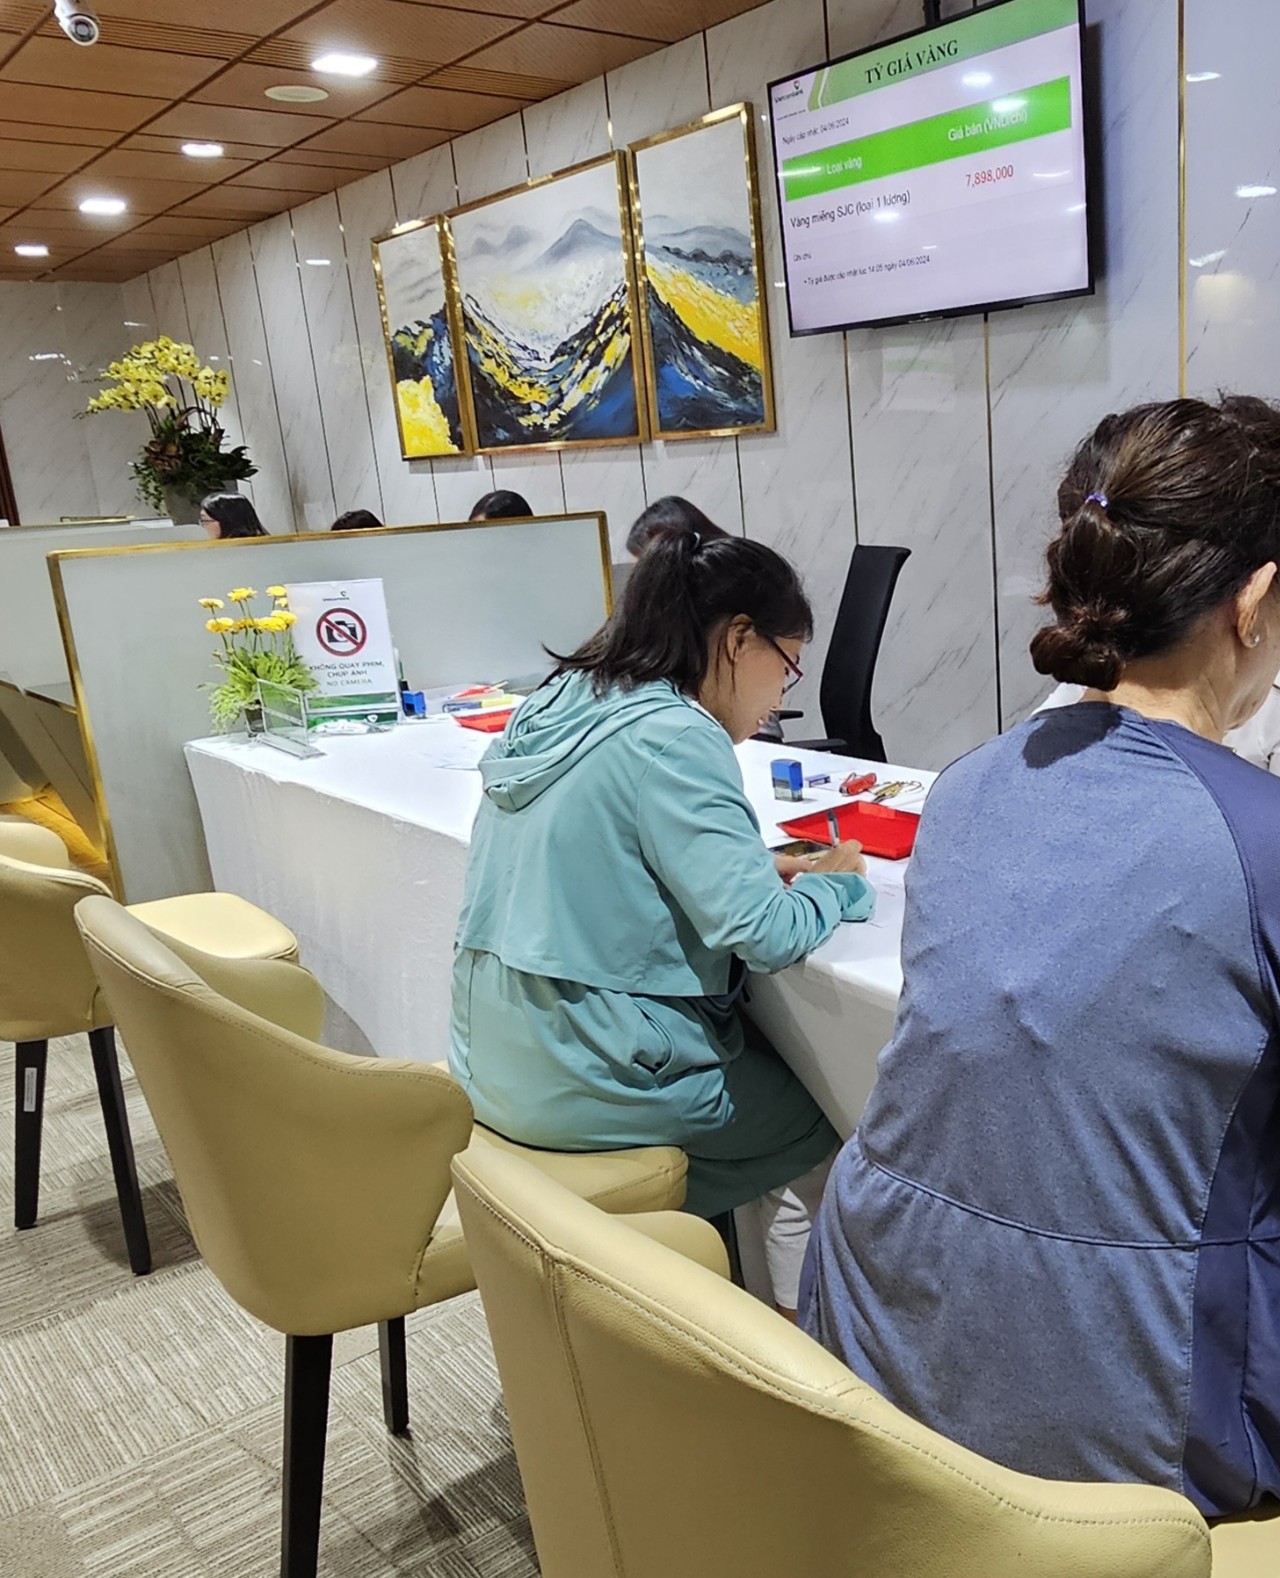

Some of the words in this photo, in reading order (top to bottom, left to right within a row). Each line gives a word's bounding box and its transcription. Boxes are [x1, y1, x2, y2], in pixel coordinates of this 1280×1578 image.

[887, 52, 912, 76] GIÁ
[916, 40, 958, 66] VÀNG
[948, 125, 963, 141] Giá
[965, 121, 981, 137] bán
[966, 165, 1014, 187] 7,898,000
[790, 217, 810, 229] Vàng
[812, 209, 835, 223] miếng
[837, 203, 854, 218] SJC
[309, 663, 337, 671] KHÔNG
[339, 662, 360, 670] QUAY
